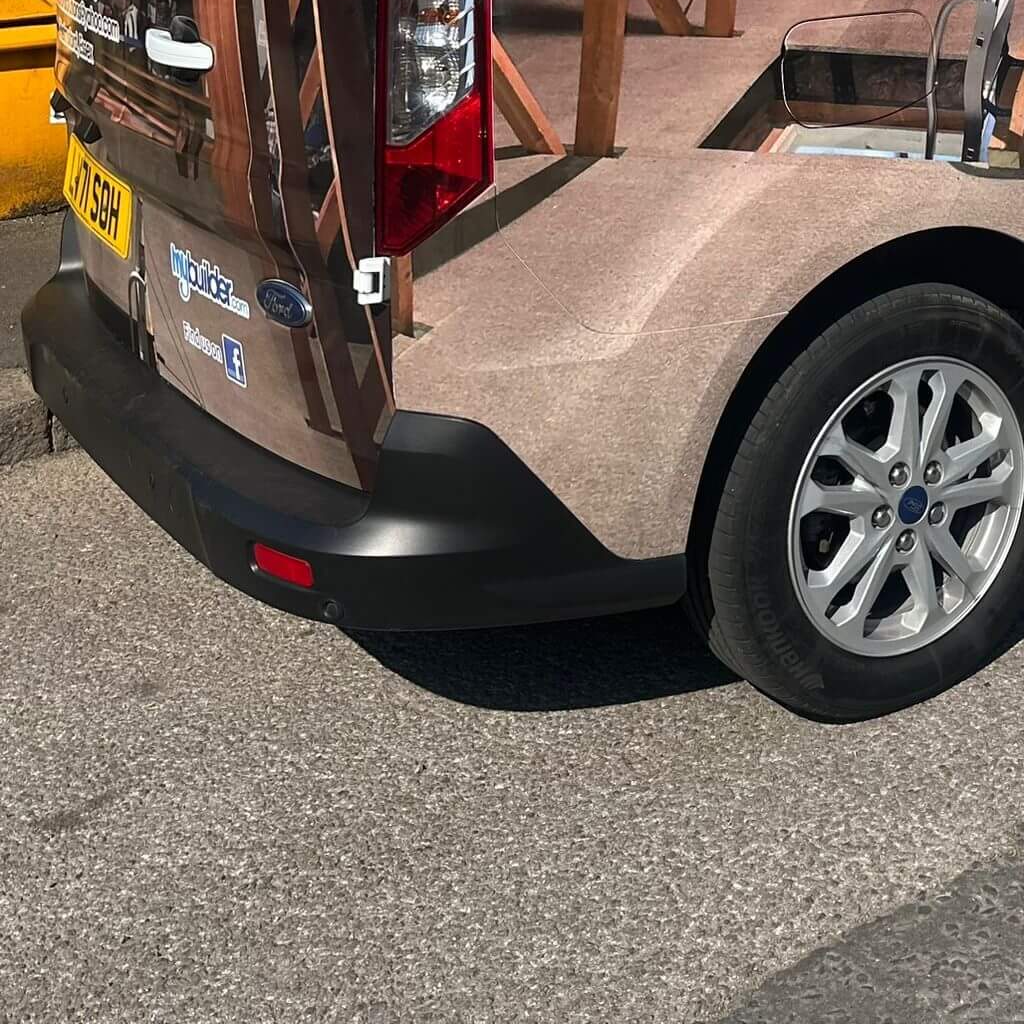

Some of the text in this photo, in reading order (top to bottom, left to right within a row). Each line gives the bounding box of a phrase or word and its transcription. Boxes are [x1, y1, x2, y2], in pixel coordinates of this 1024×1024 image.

[170, 242, 250, 320] mybuilder.com
[263, 289, 295, 320] Ford
[183, 321, 201, 350] Find
[211, 341, 223, 364] on
